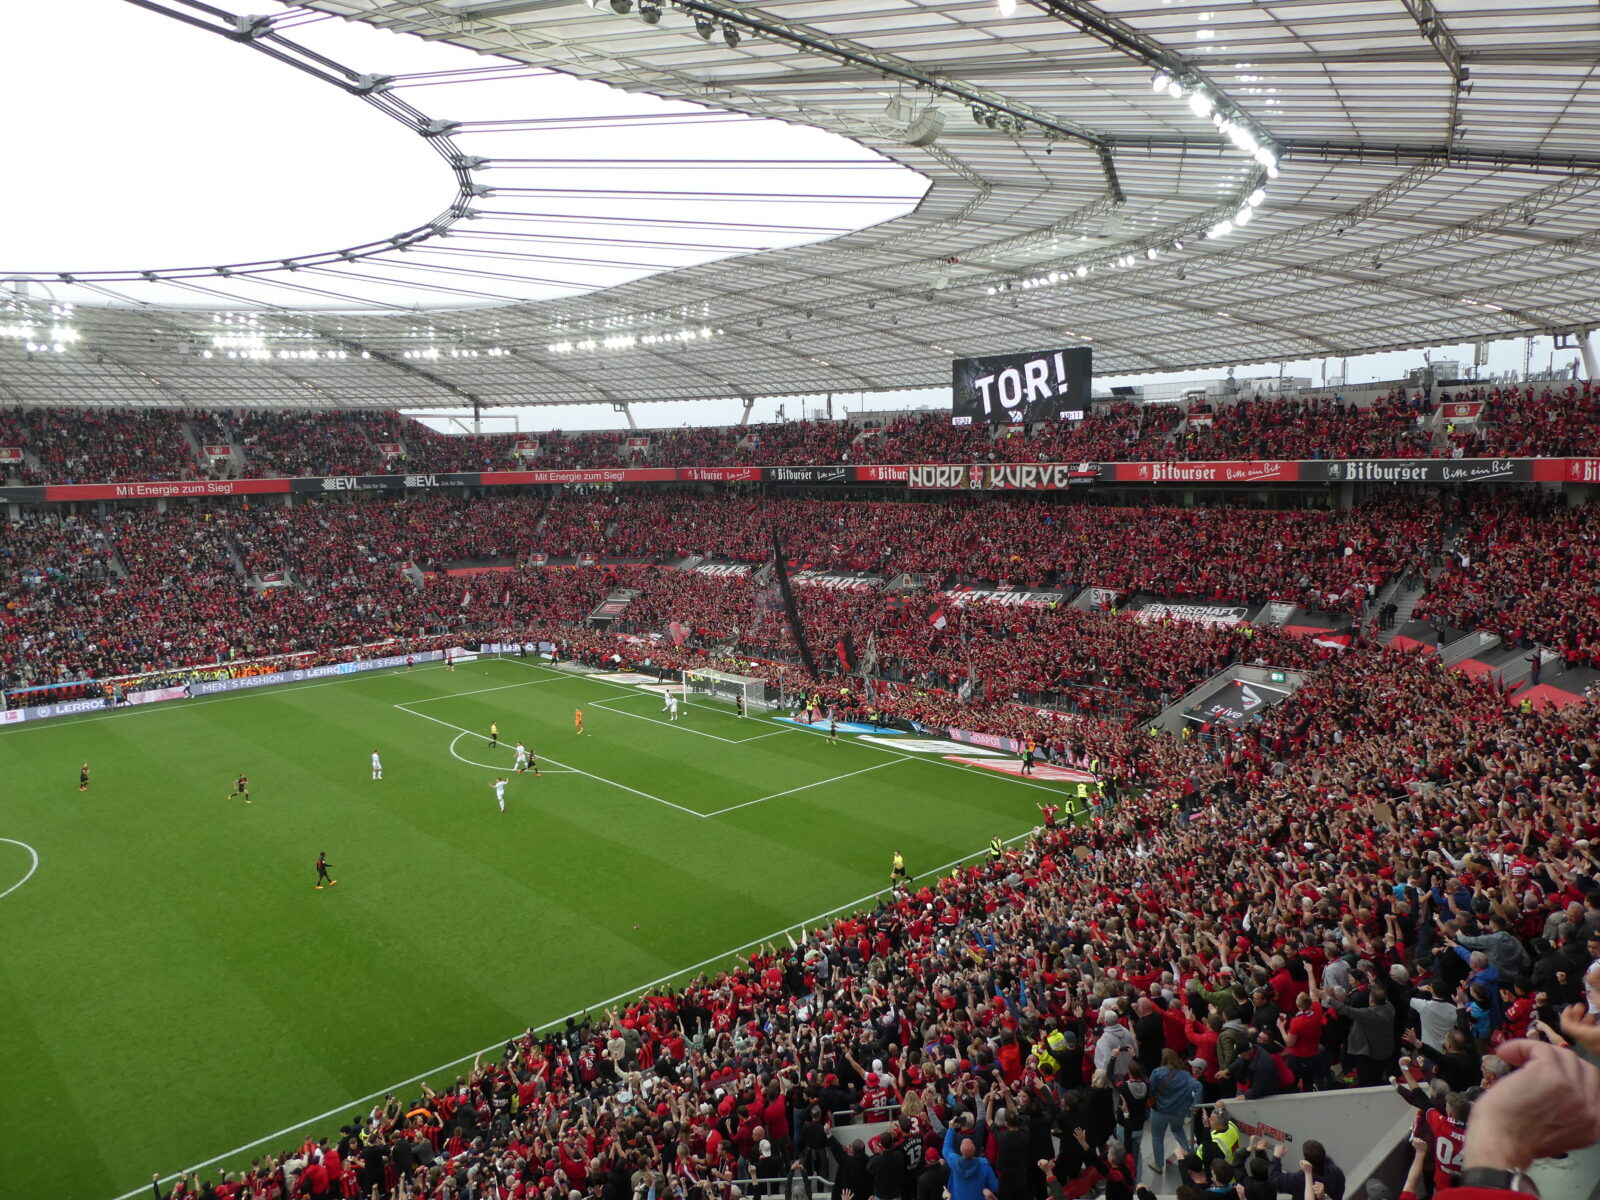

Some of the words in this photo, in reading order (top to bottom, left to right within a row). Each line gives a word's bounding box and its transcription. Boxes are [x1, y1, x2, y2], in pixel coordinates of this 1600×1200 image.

[974, 352, 1068, 415] TOR!
[535, 473, 548, 481] Mit
[550, 473, 582, 483] Energie
[604, 471, 625, 481] Sieg!
[694, 470, 723, 480] Btburger
[778, 468, 812, 480] Bitburger
[878, 467, 908, 480] Bitbur
[909, 466, 964, 488] NORD
[970, 480, 981, 489] 04
[991, 465, 1068, 487] KURVE
[1152, 464, 1216, 480] Bitburger
[1226, 469, 1247, 480] Bitte
[1247, 468, 1263, 476] ein
[1264, 463, 1281, 473] Bit
[1346, 462, 1429, 480] Bitburger
[1442, 466, 1468, 480] Bitte
[1470, 466, 1491, 476] ein
[1491, 461, 1514, 474] Bit
[336, 477, 359, 490] EVL
[416, 475, 439, 486] EVL
[116, 486, 134, 496] Mit
[137, 484, 180, 497] Energie
[182, 485, 205, 493] zum
[207, 483, 234, 495] Sieg!
[240, 674, 284, 688] FASHION
